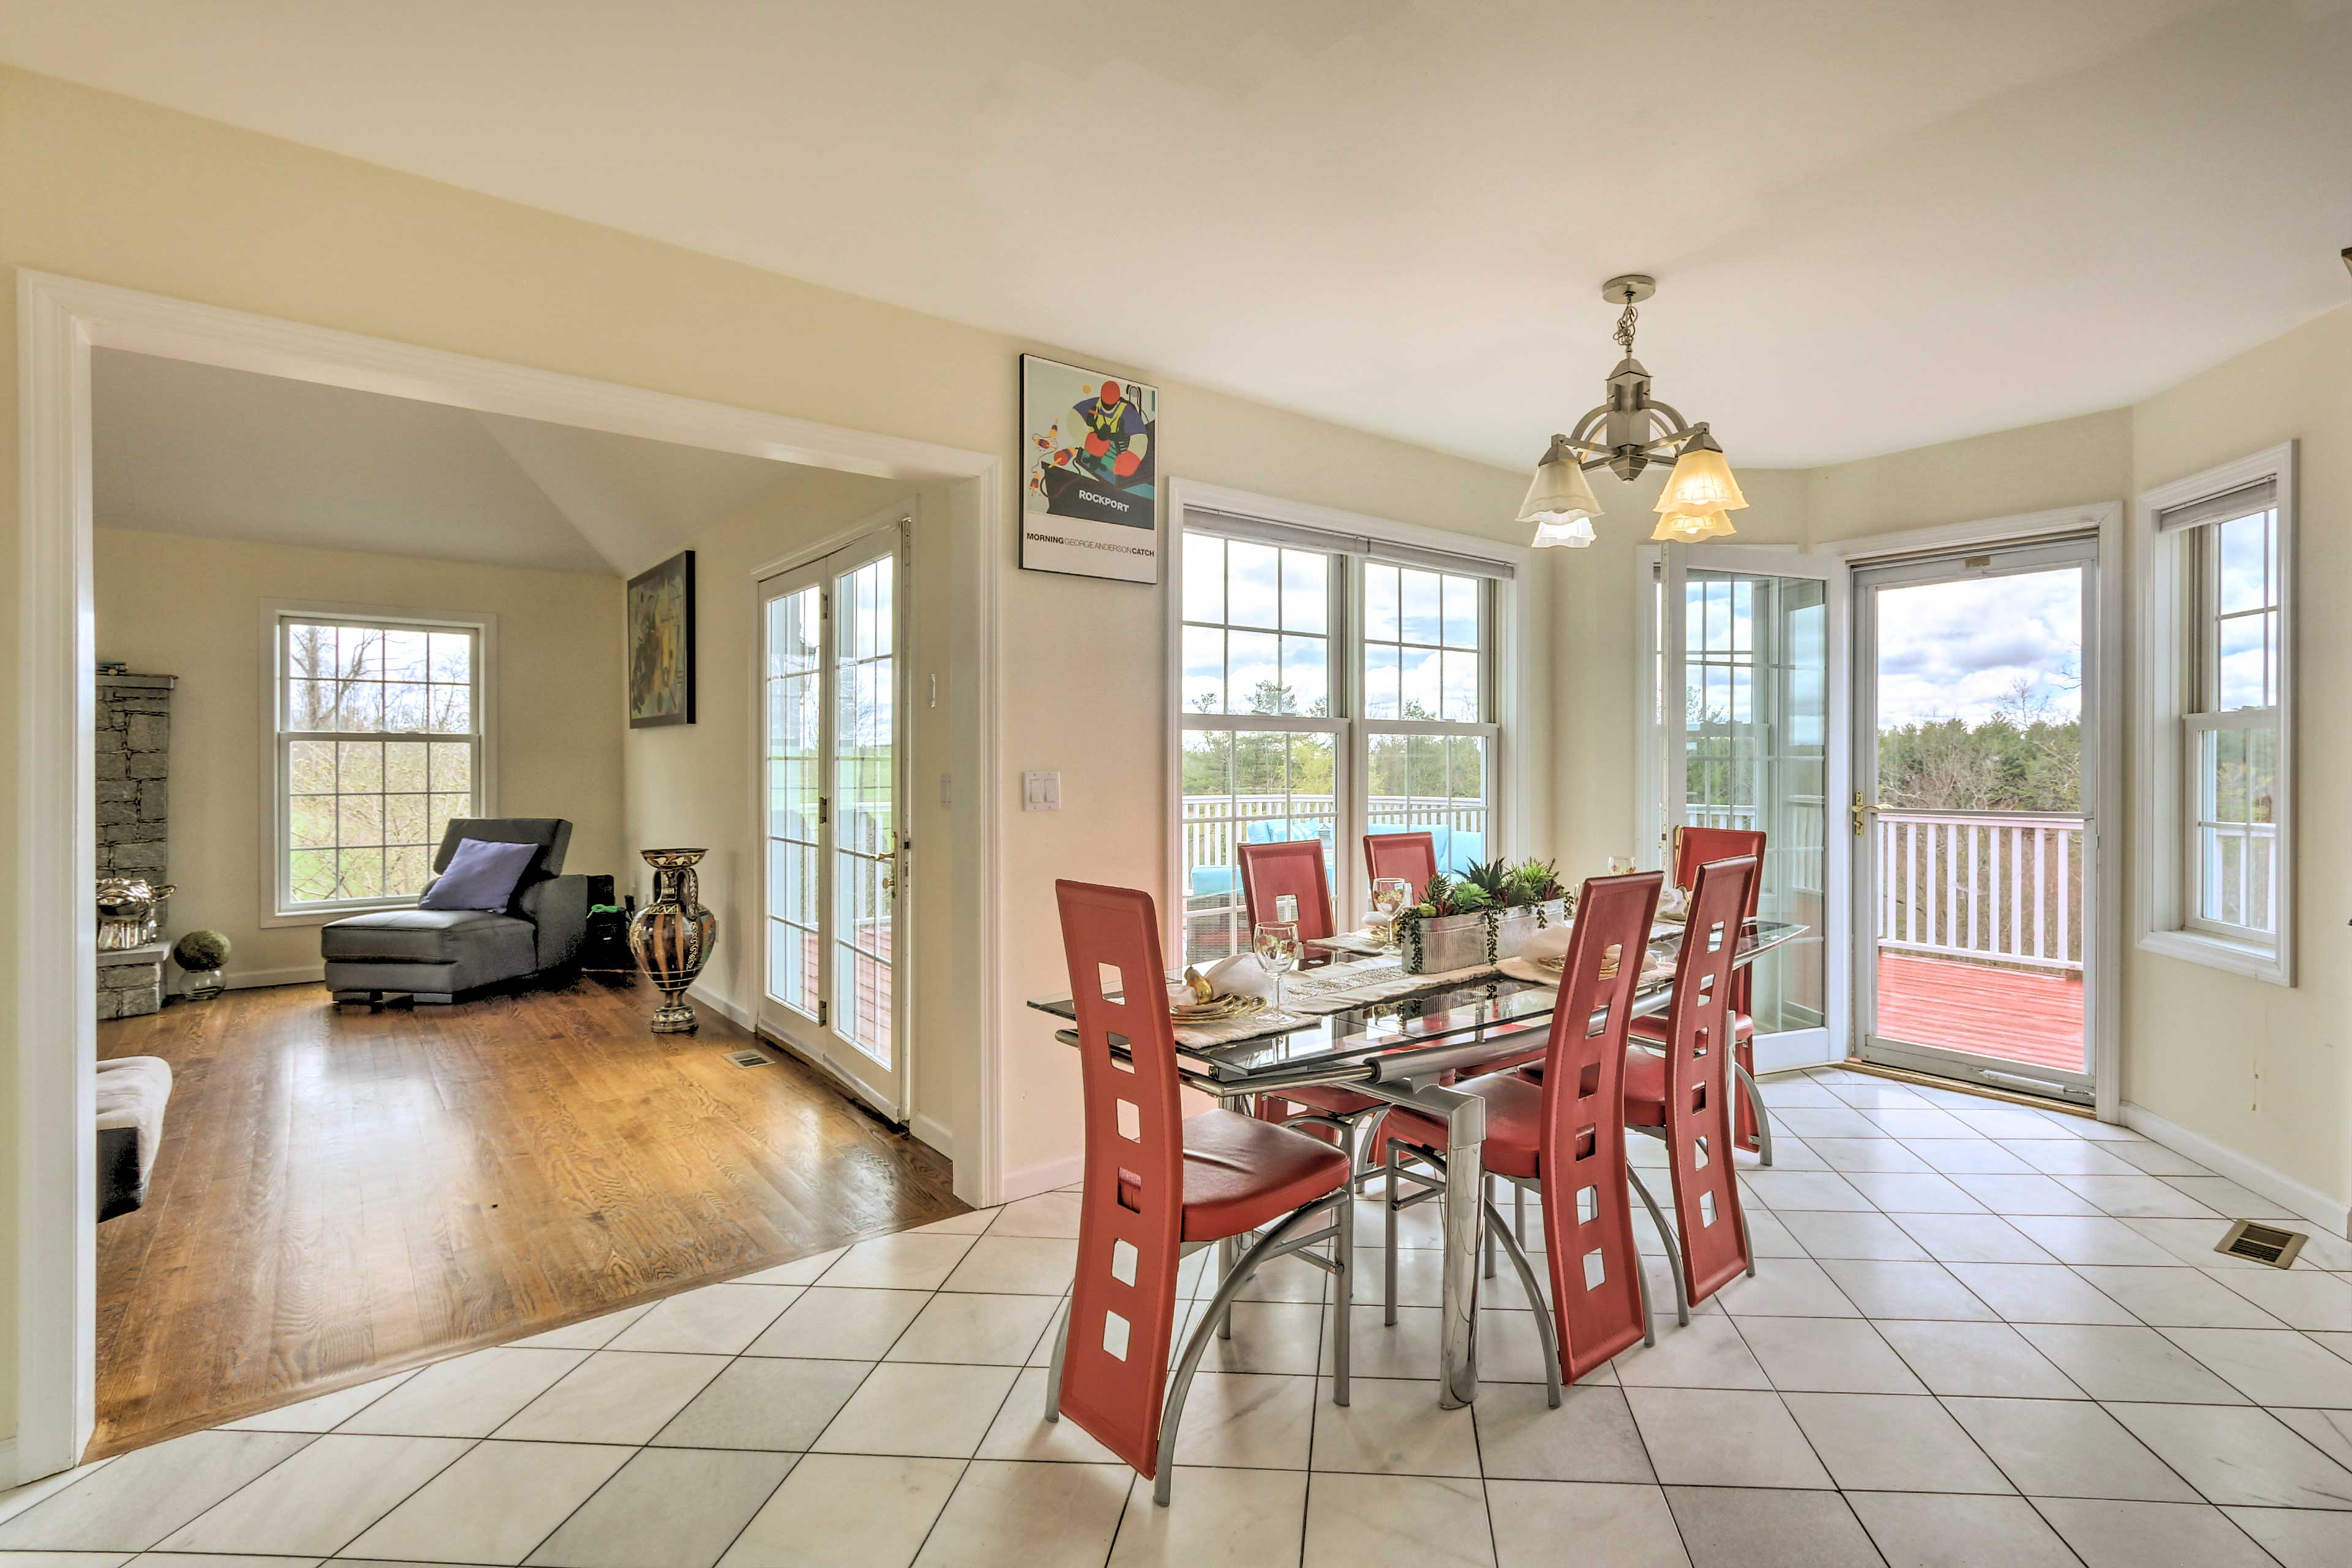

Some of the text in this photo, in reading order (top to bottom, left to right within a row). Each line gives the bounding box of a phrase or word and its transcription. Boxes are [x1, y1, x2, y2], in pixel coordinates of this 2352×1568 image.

[1079, 489, 1129, 513] ROCKPORT
[1027, 532, 1155, 557] MORNING GEORGE ANDERSON CATCH
